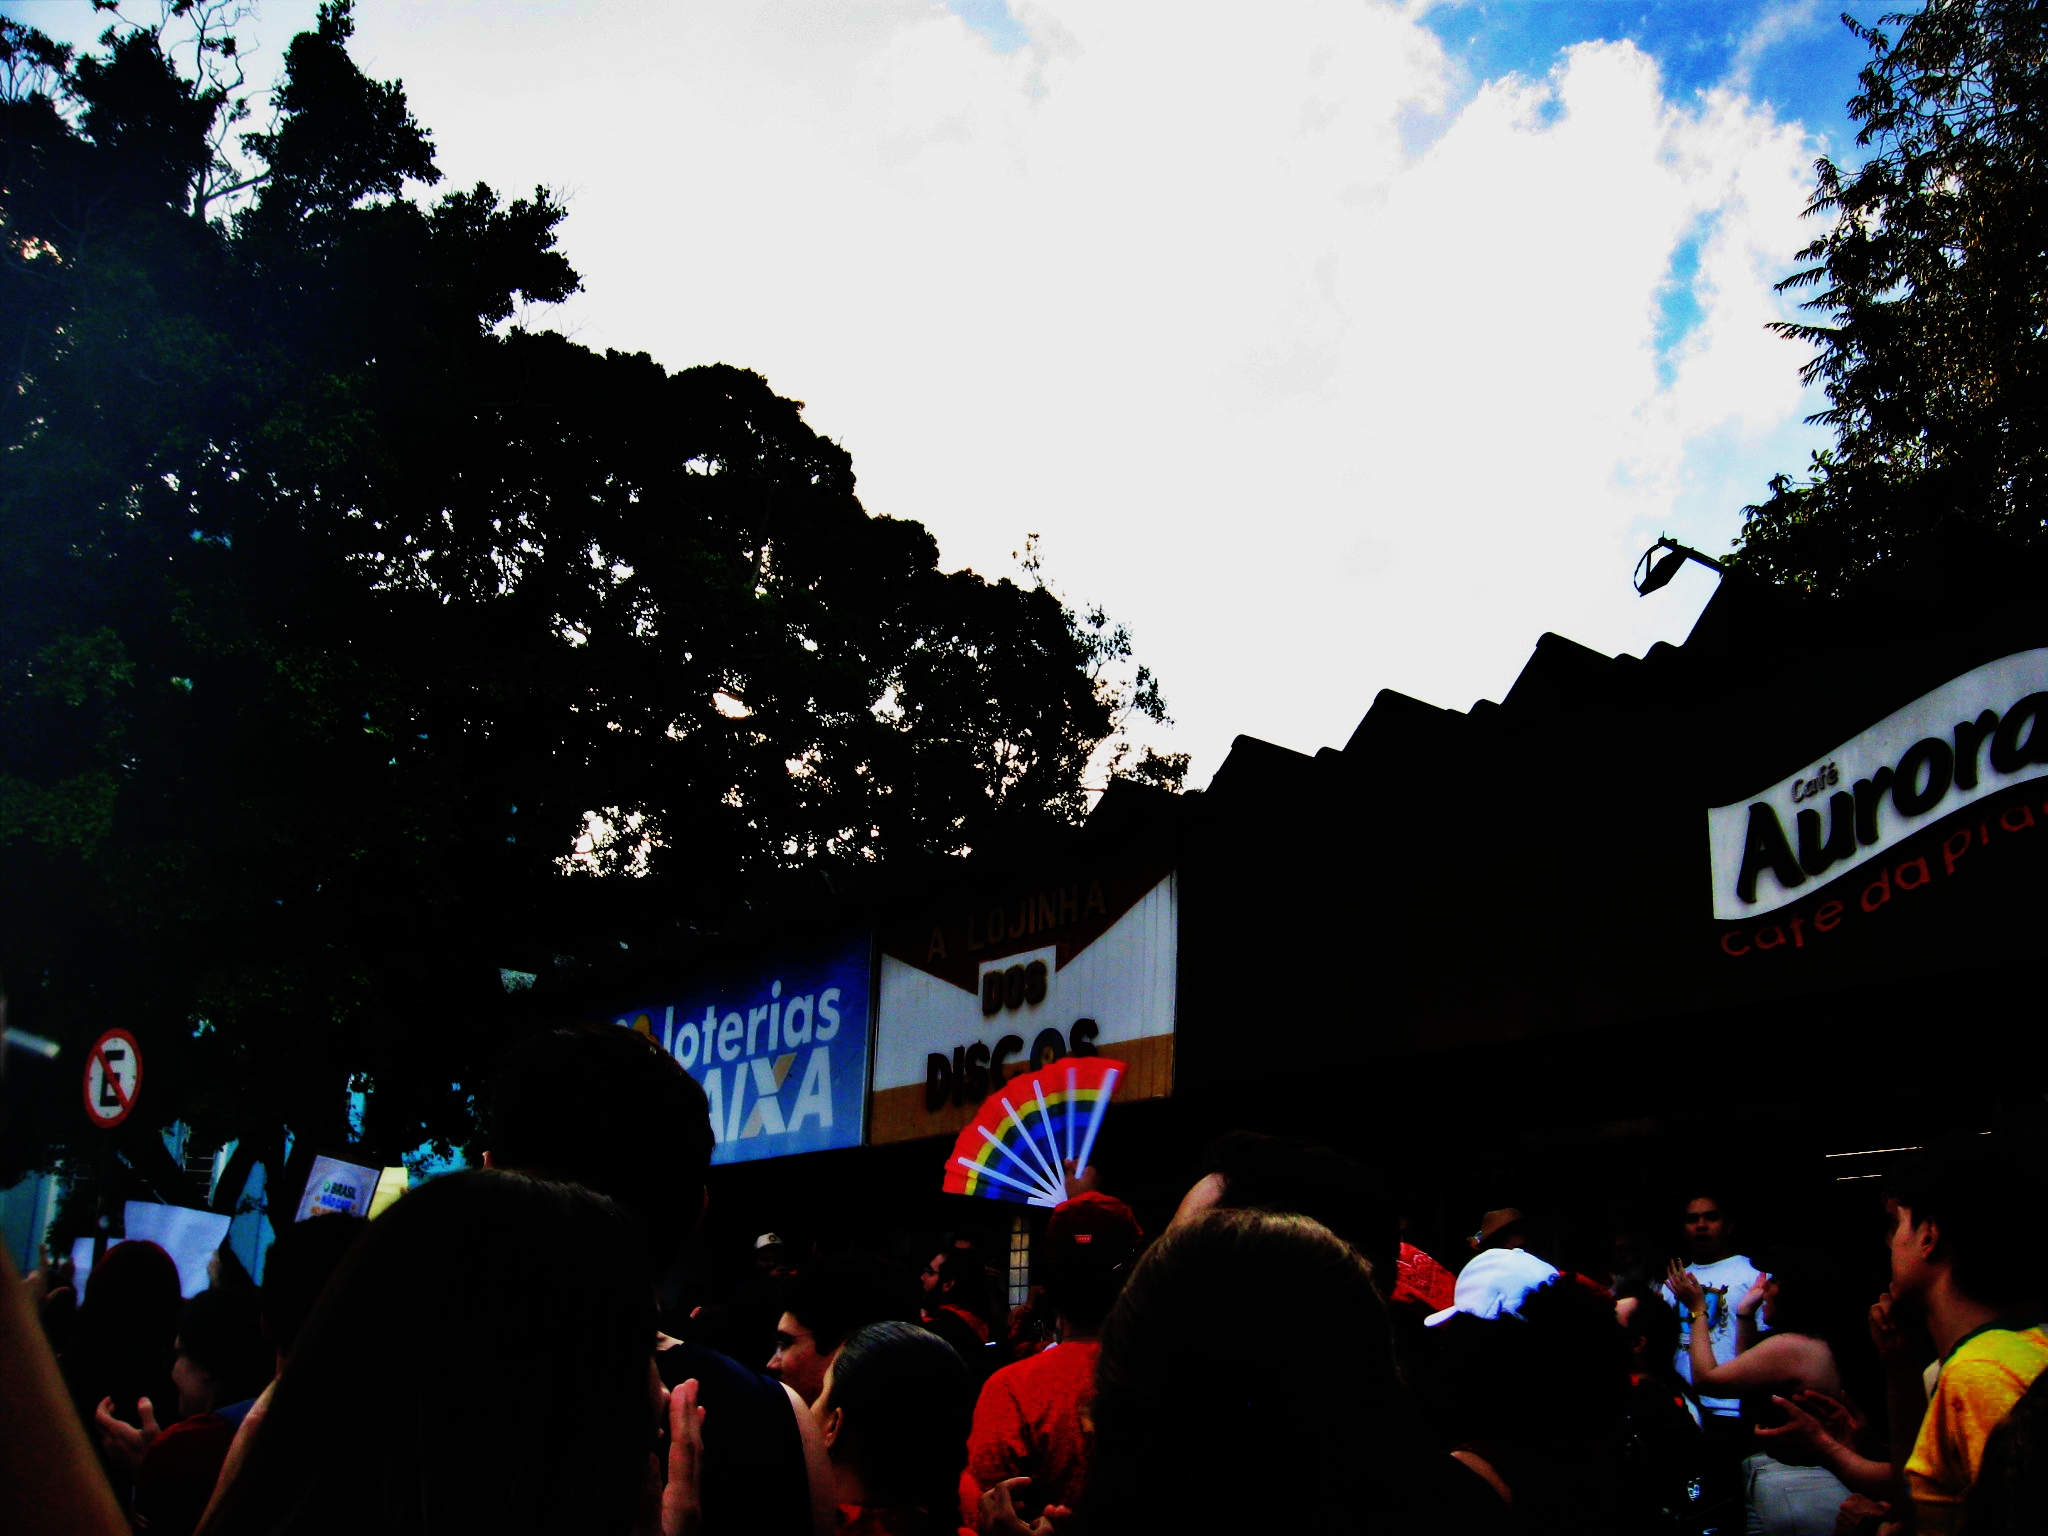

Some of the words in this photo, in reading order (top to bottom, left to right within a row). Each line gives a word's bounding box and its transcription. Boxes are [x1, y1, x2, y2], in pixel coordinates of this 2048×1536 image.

[1791, 762, 1839, 803] Café
[926, 925, 947, 963] A
[966, 877, 1107, 951] LOJINHA
[1859, 854, 1931, 914] da
[982, 959, 1047, 1014] DOS
[662, 980, 841, 1071] loterias
[703, 1045, 833, 1144] AIXA
